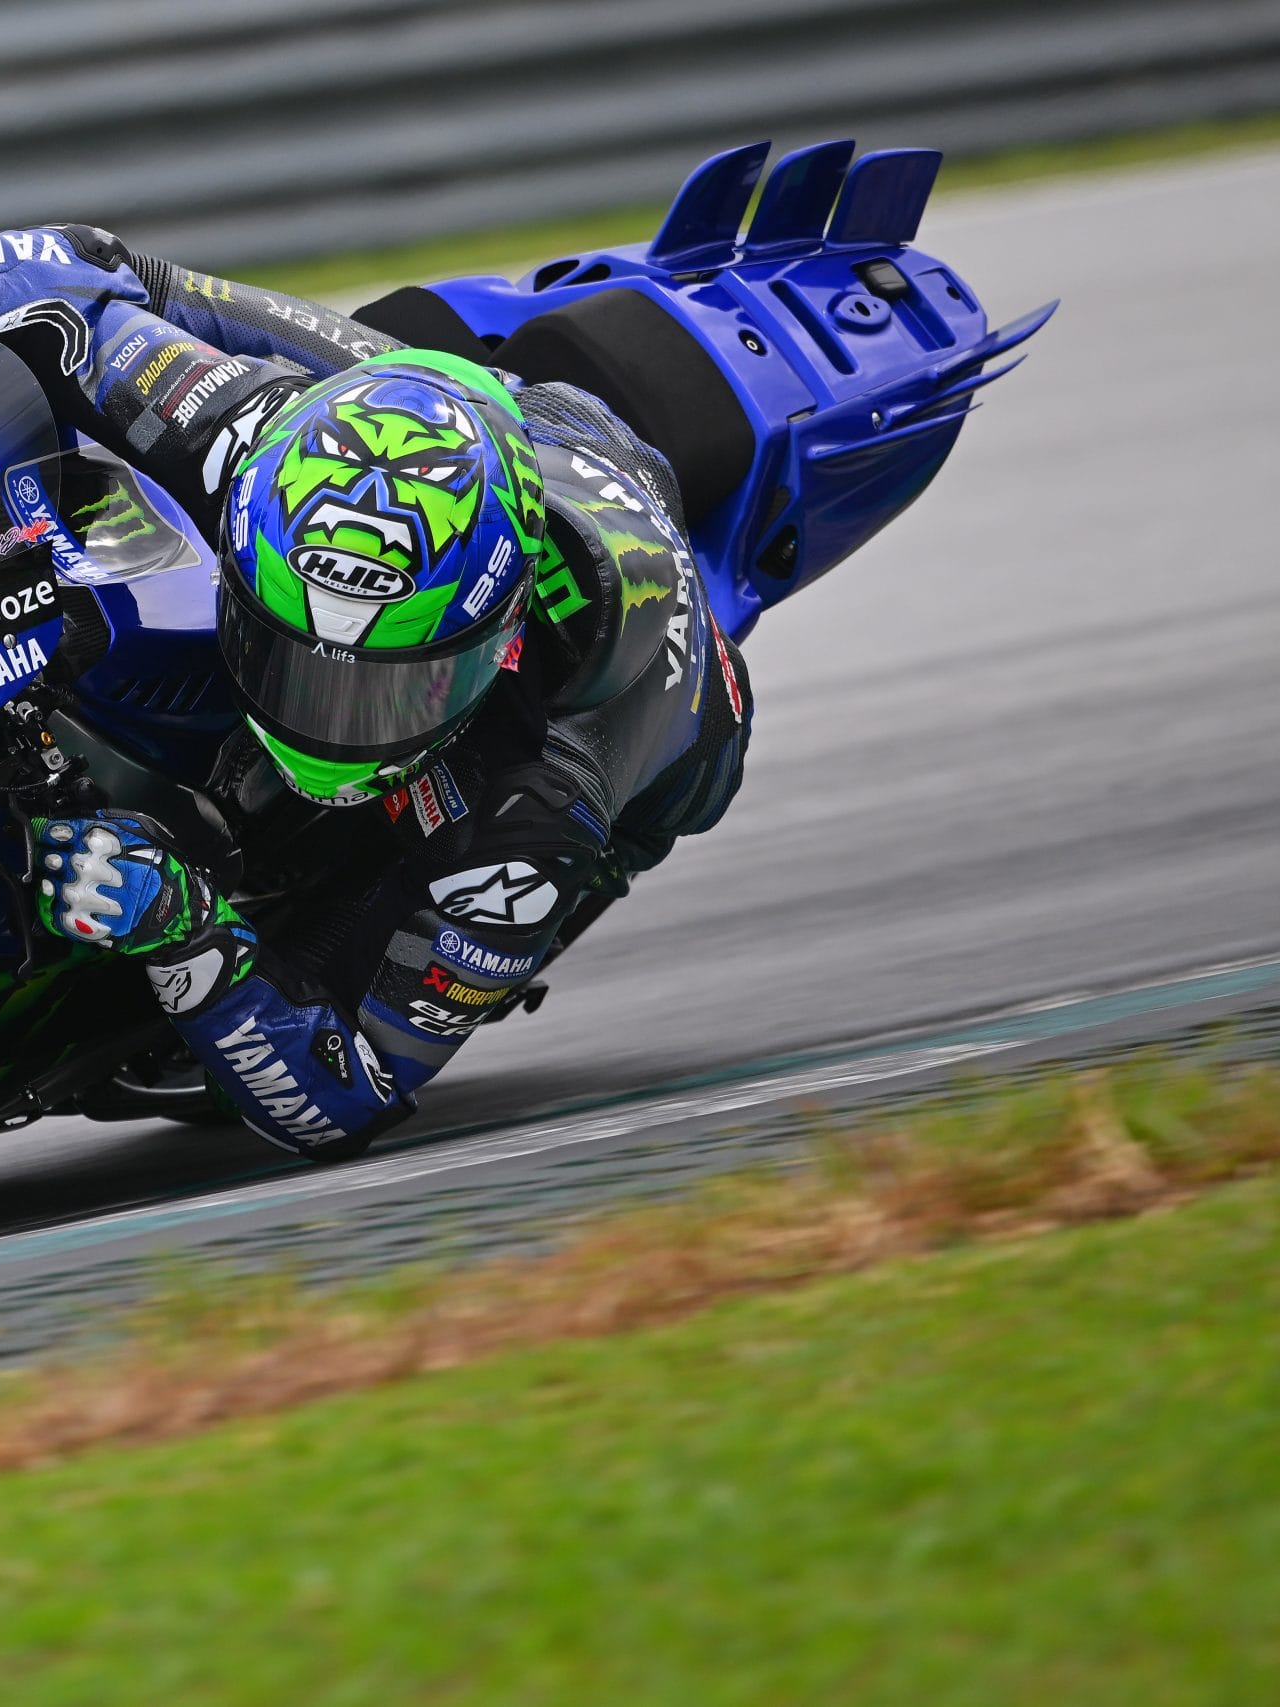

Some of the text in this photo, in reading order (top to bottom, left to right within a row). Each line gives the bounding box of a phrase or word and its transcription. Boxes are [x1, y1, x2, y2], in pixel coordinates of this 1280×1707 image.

[111, 334, 146, 369] INDIA
[172, 359, 250, 429] YAMALUBE
[302, 553, 399, 593] HJC
[324, 579, 368, 594] HELMETS
[462, 534, 512, 618] BS
[331, 648, 356, 664] lif3
[434, 764, 458, 810] ICHELIN
[461, 941, 533, 973] YAMAHA
[215, 1016, 347, 1146] YAMAHA
